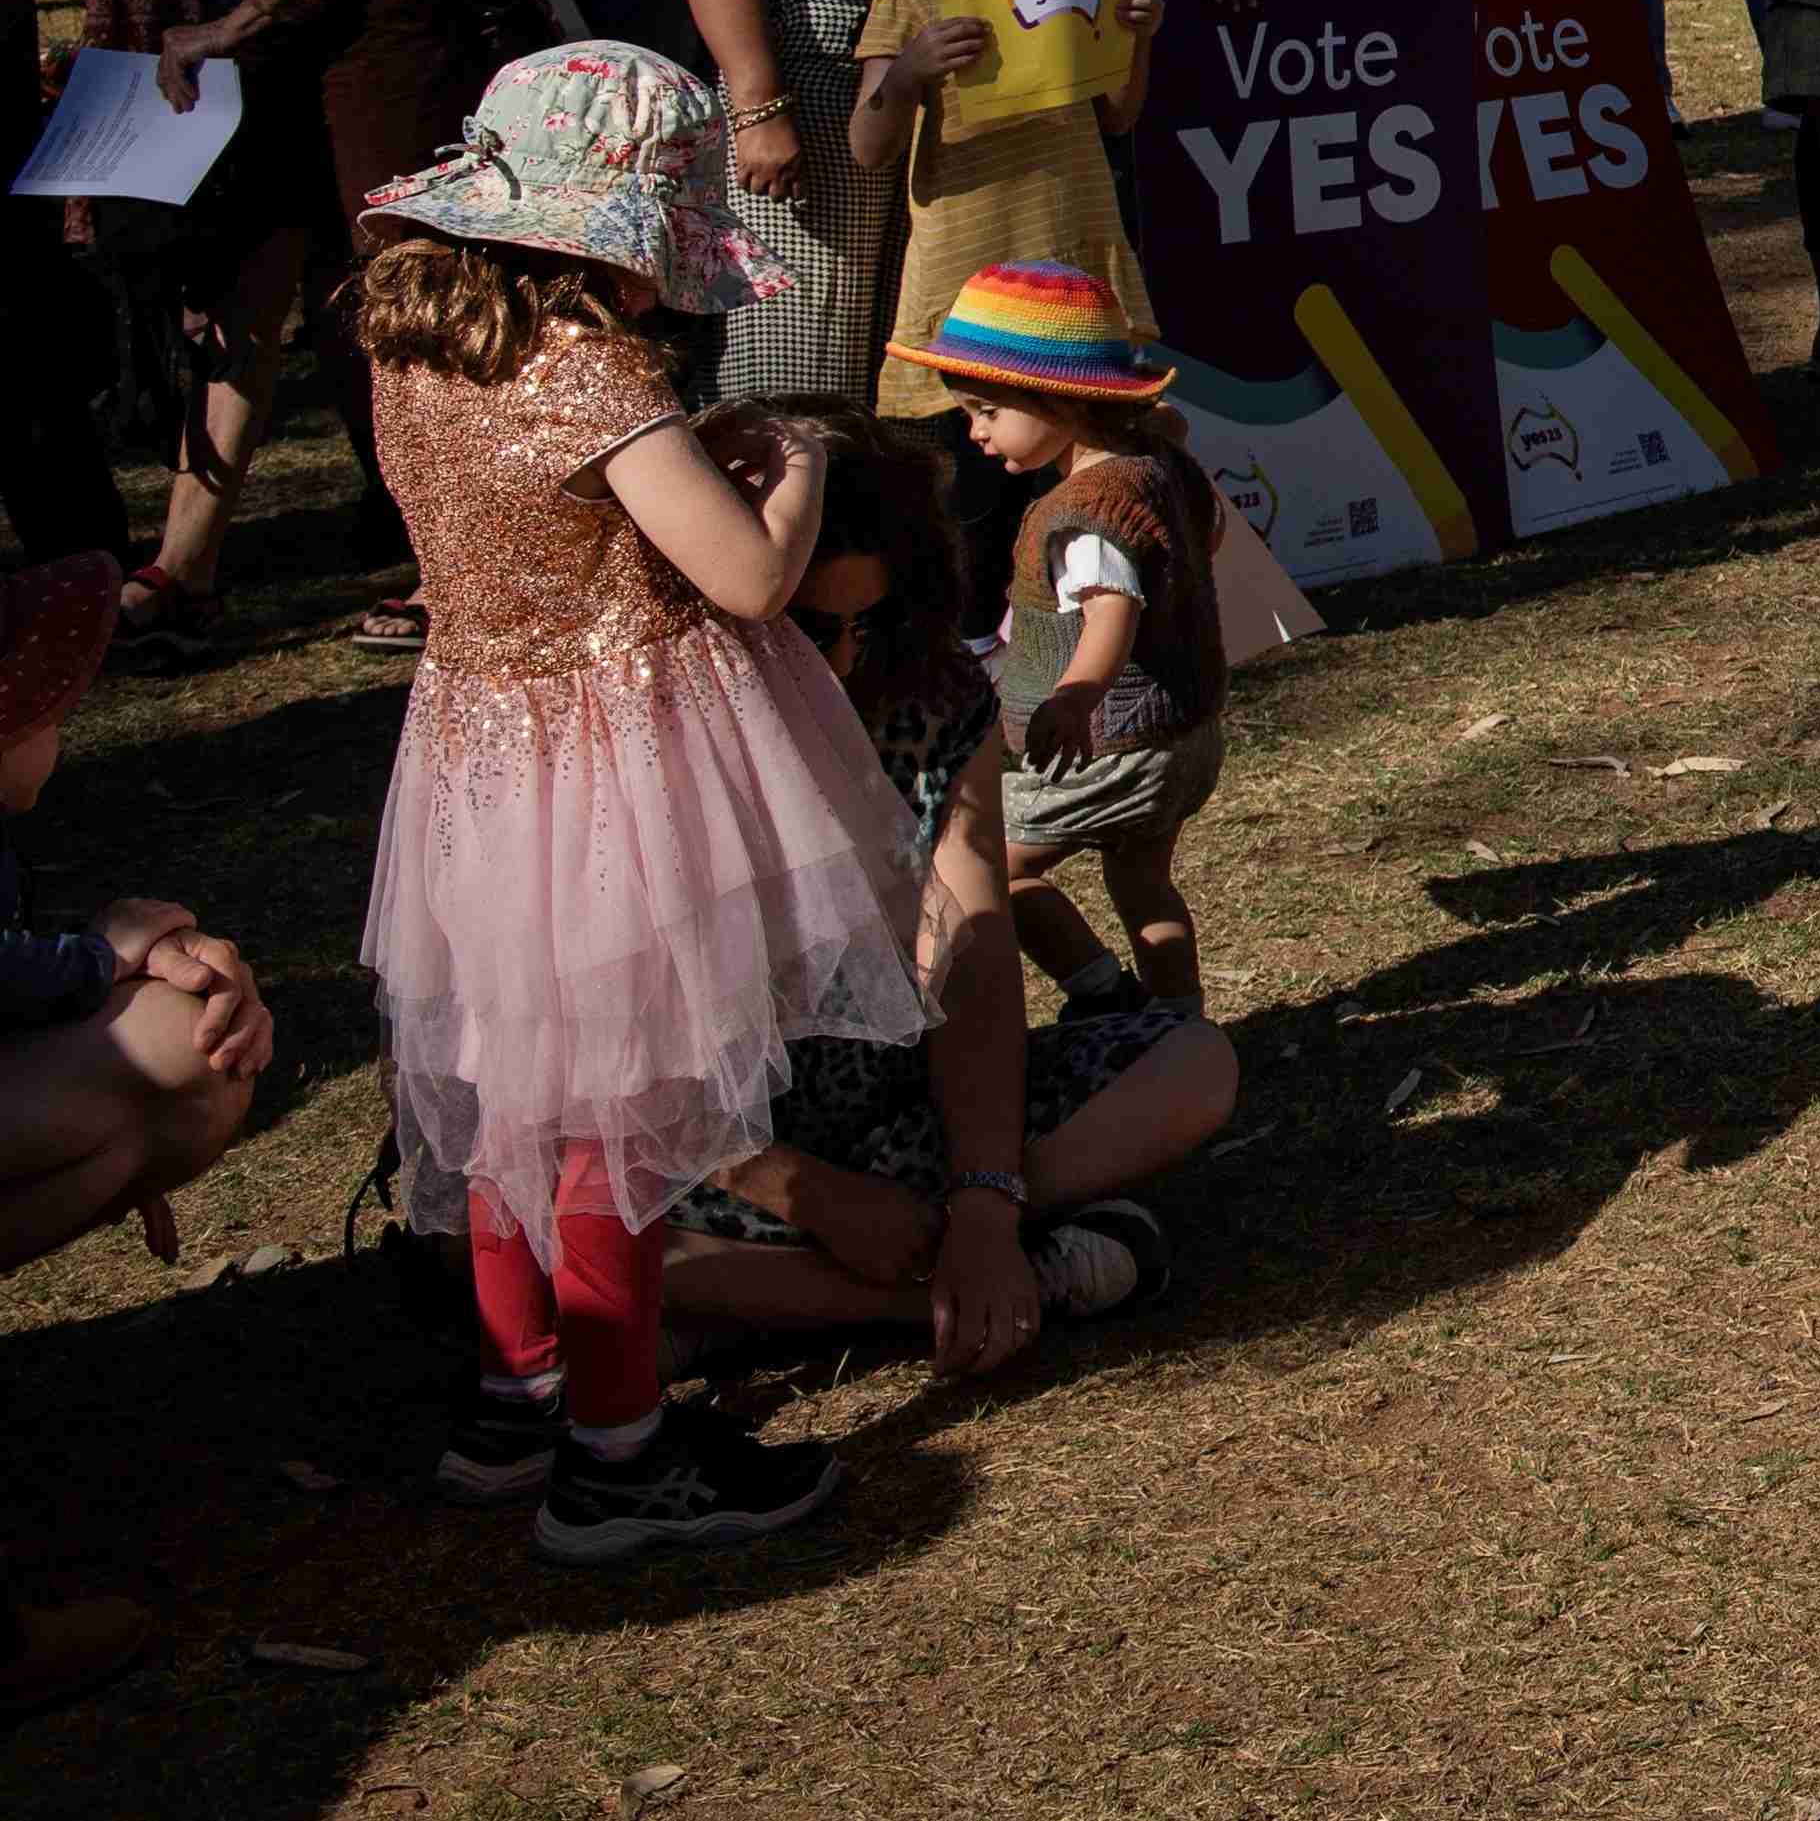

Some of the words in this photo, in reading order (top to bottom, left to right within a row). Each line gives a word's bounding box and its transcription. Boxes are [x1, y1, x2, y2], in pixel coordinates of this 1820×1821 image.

[1216, 21, 1399, 99] Vote
[1474, 10, 1591, 79] ote
[1175, 101, 1444, 245] YES
[1520, 428, 1563, 452] yes23
